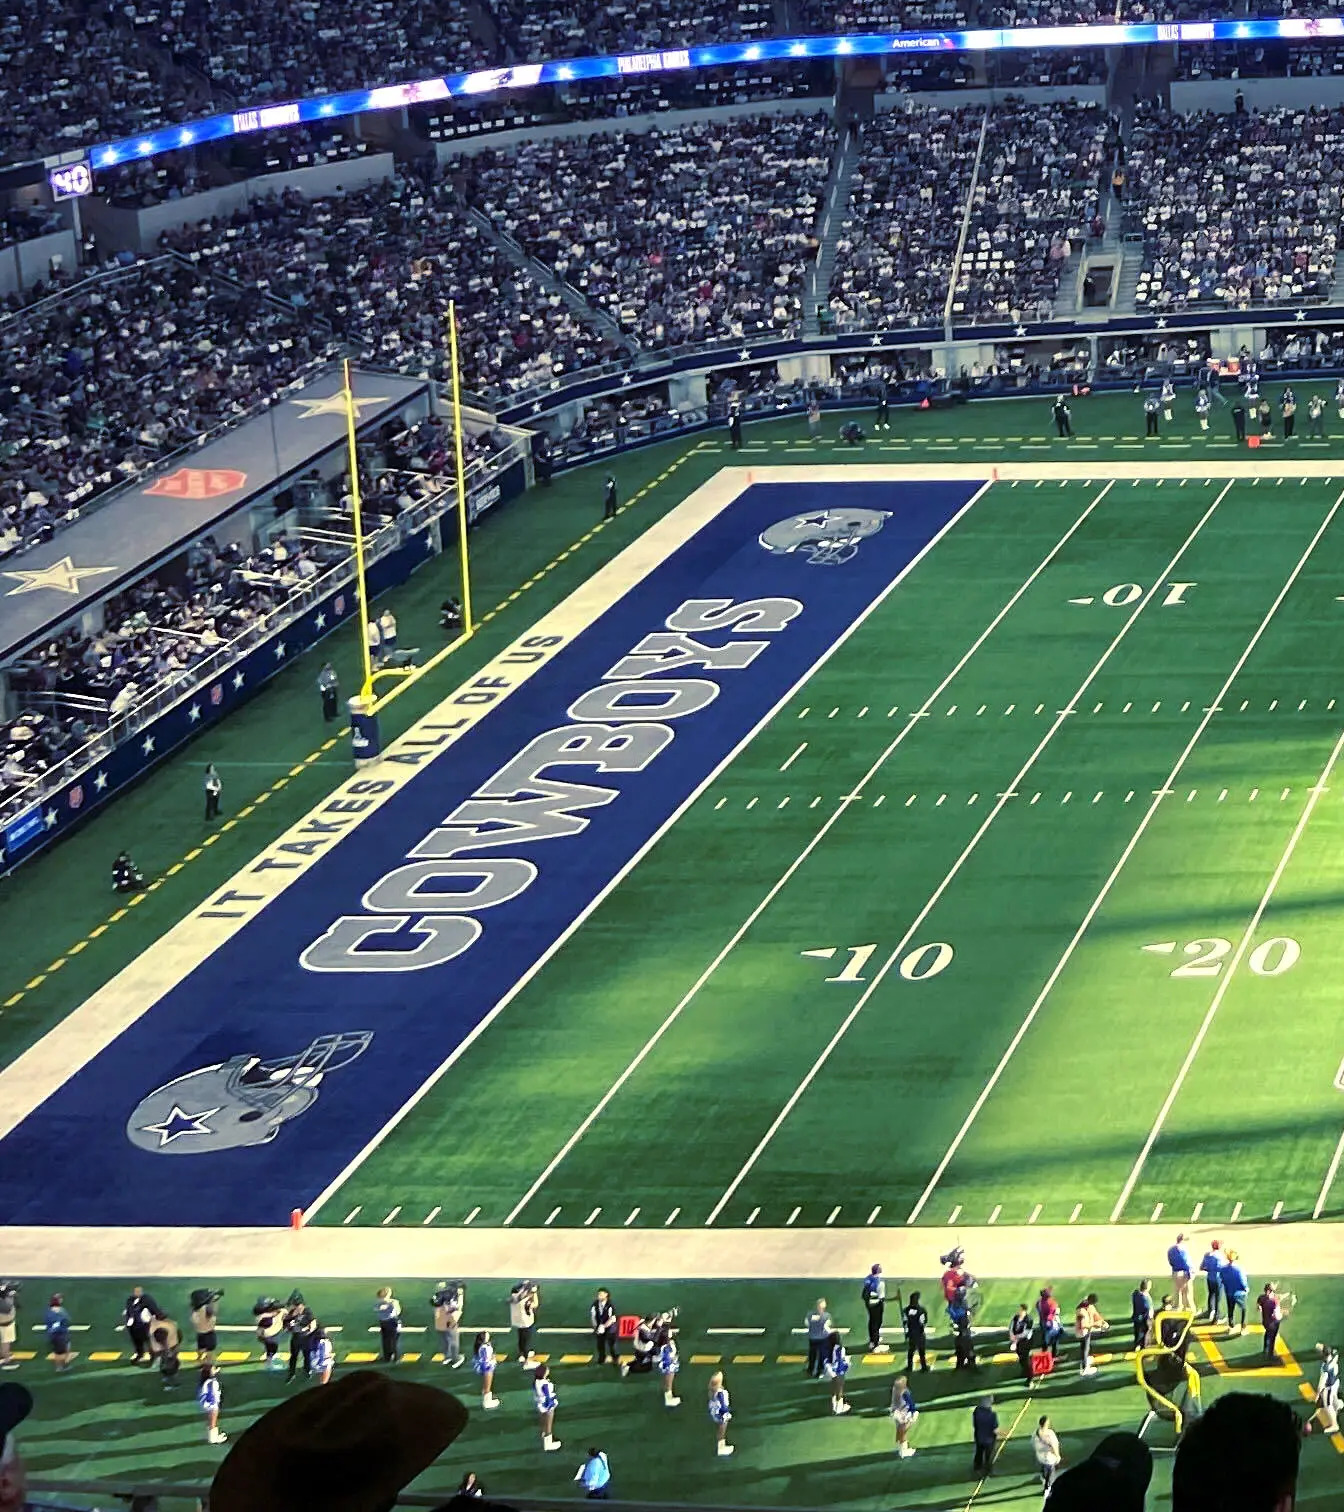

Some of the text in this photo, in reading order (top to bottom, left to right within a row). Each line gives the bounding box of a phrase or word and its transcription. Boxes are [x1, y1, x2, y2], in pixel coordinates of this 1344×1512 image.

[892, 37, 940, 49] American
[1100, 582, 1198, 608] 10
[199, 883, 256, 920] IT
[252, 776, 397, 874] TAKES
[385, 717, 470, 765] ALL
[454, 675, 512, 705] OF
[523, 633, 566, 668] US
[299, 596, 804, 973] COWBOYS
[824, 941, 956, 983] 10
[1170, 936, 1301, 977] 20
